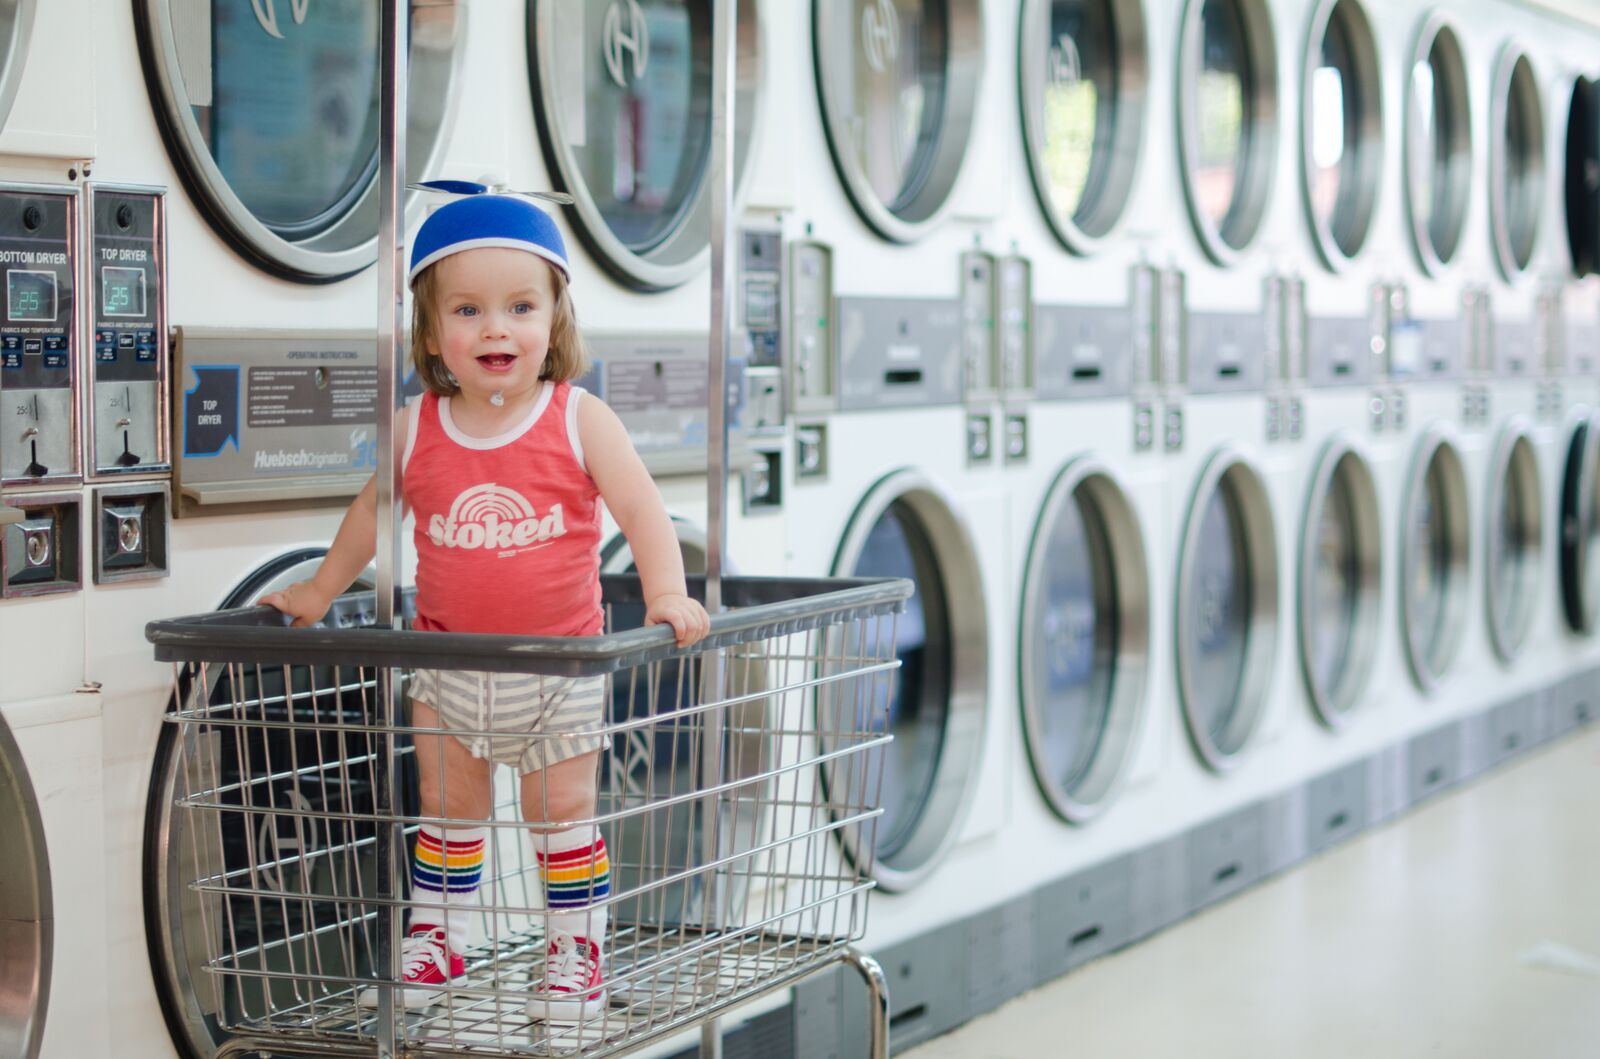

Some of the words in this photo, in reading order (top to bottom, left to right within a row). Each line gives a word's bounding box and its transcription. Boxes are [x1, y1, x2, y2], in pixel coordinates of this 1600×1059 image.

[0, 251, 35, 264] BOTTOM
[36, 253, 67, 265] DRYER
[101, 248, 118, 260] TOP
[119, 249, 147, 262] DRYER
[203, 400, 218, 411] TOP
[198, 414, 222, 426] DRYER
